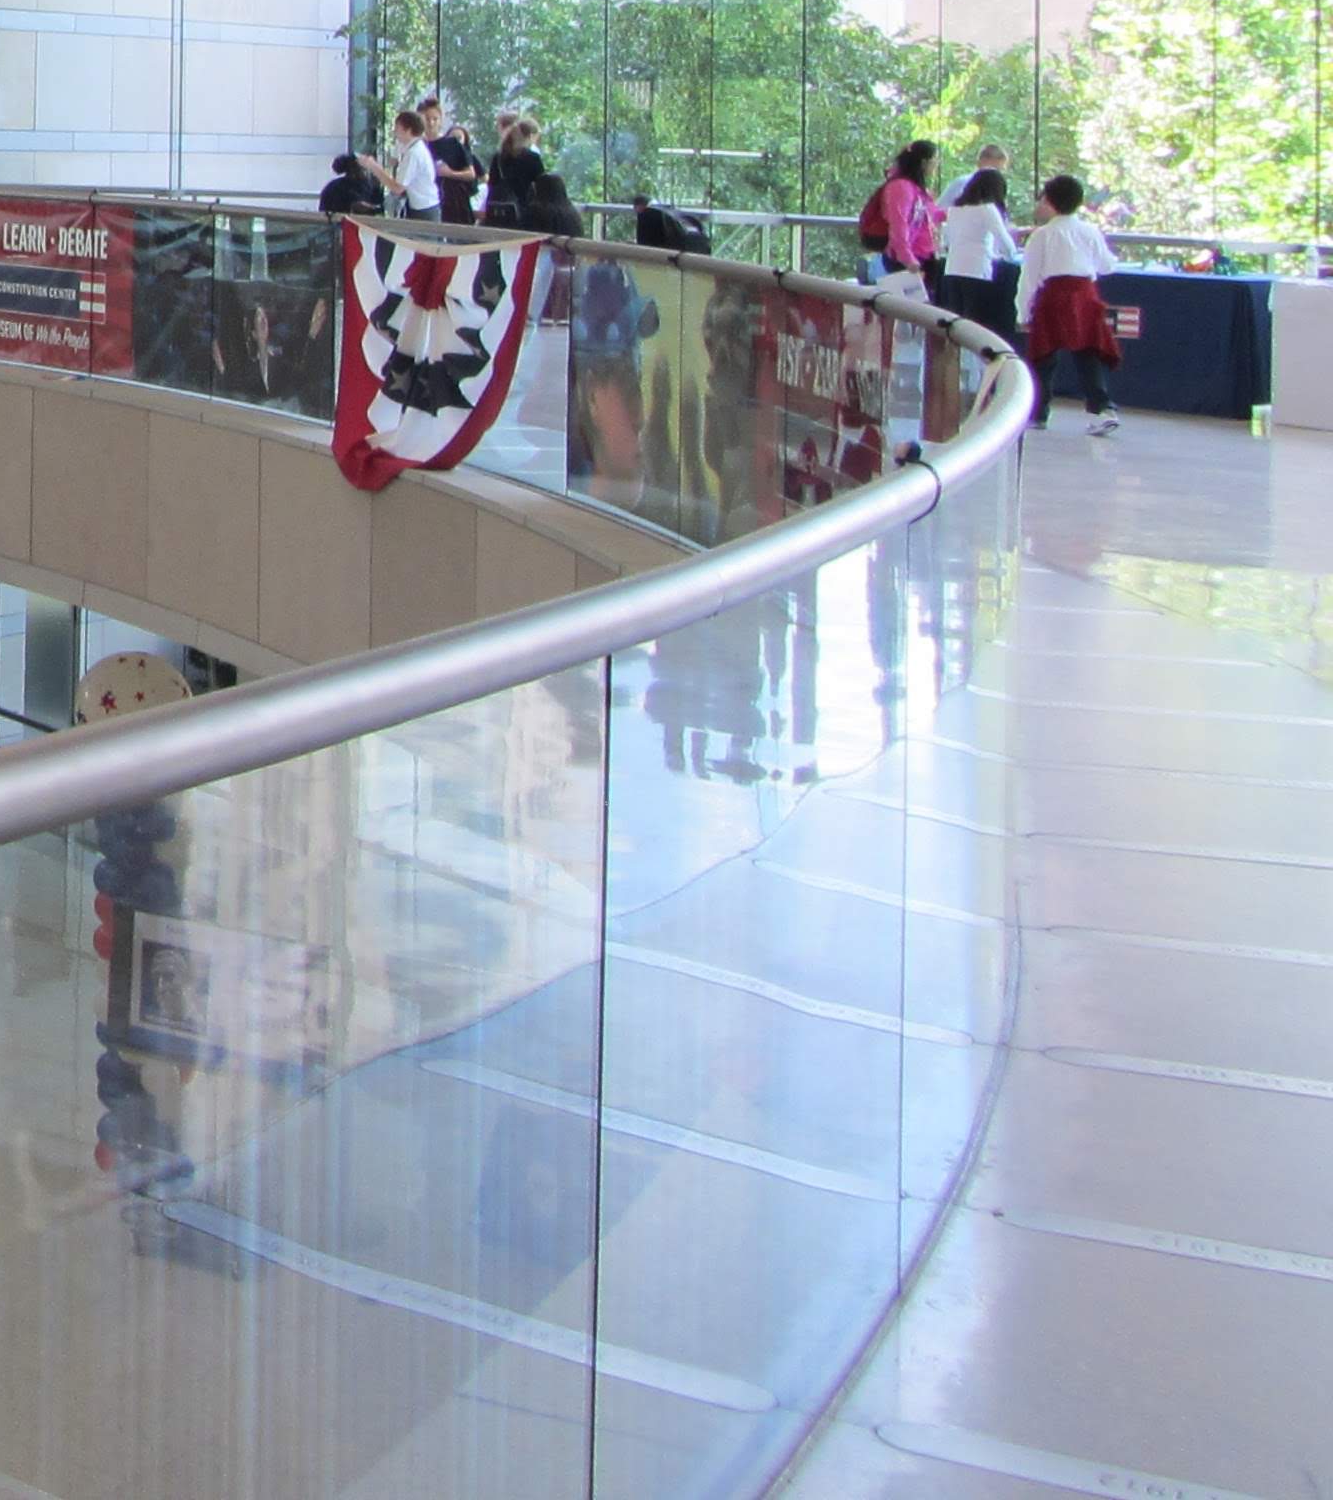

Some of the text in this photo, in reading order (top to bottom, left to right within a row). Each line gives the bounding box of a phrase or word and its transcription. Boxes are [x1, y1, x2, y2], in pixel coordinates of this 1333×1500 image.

[3, 222, 46, 253] LEARN
[58, 227, 108, 260] DEBATE
[49, 286, 77, 301] CENTER
[23, 322, 34, 341] OF
[62, 327, 90, 353] People
